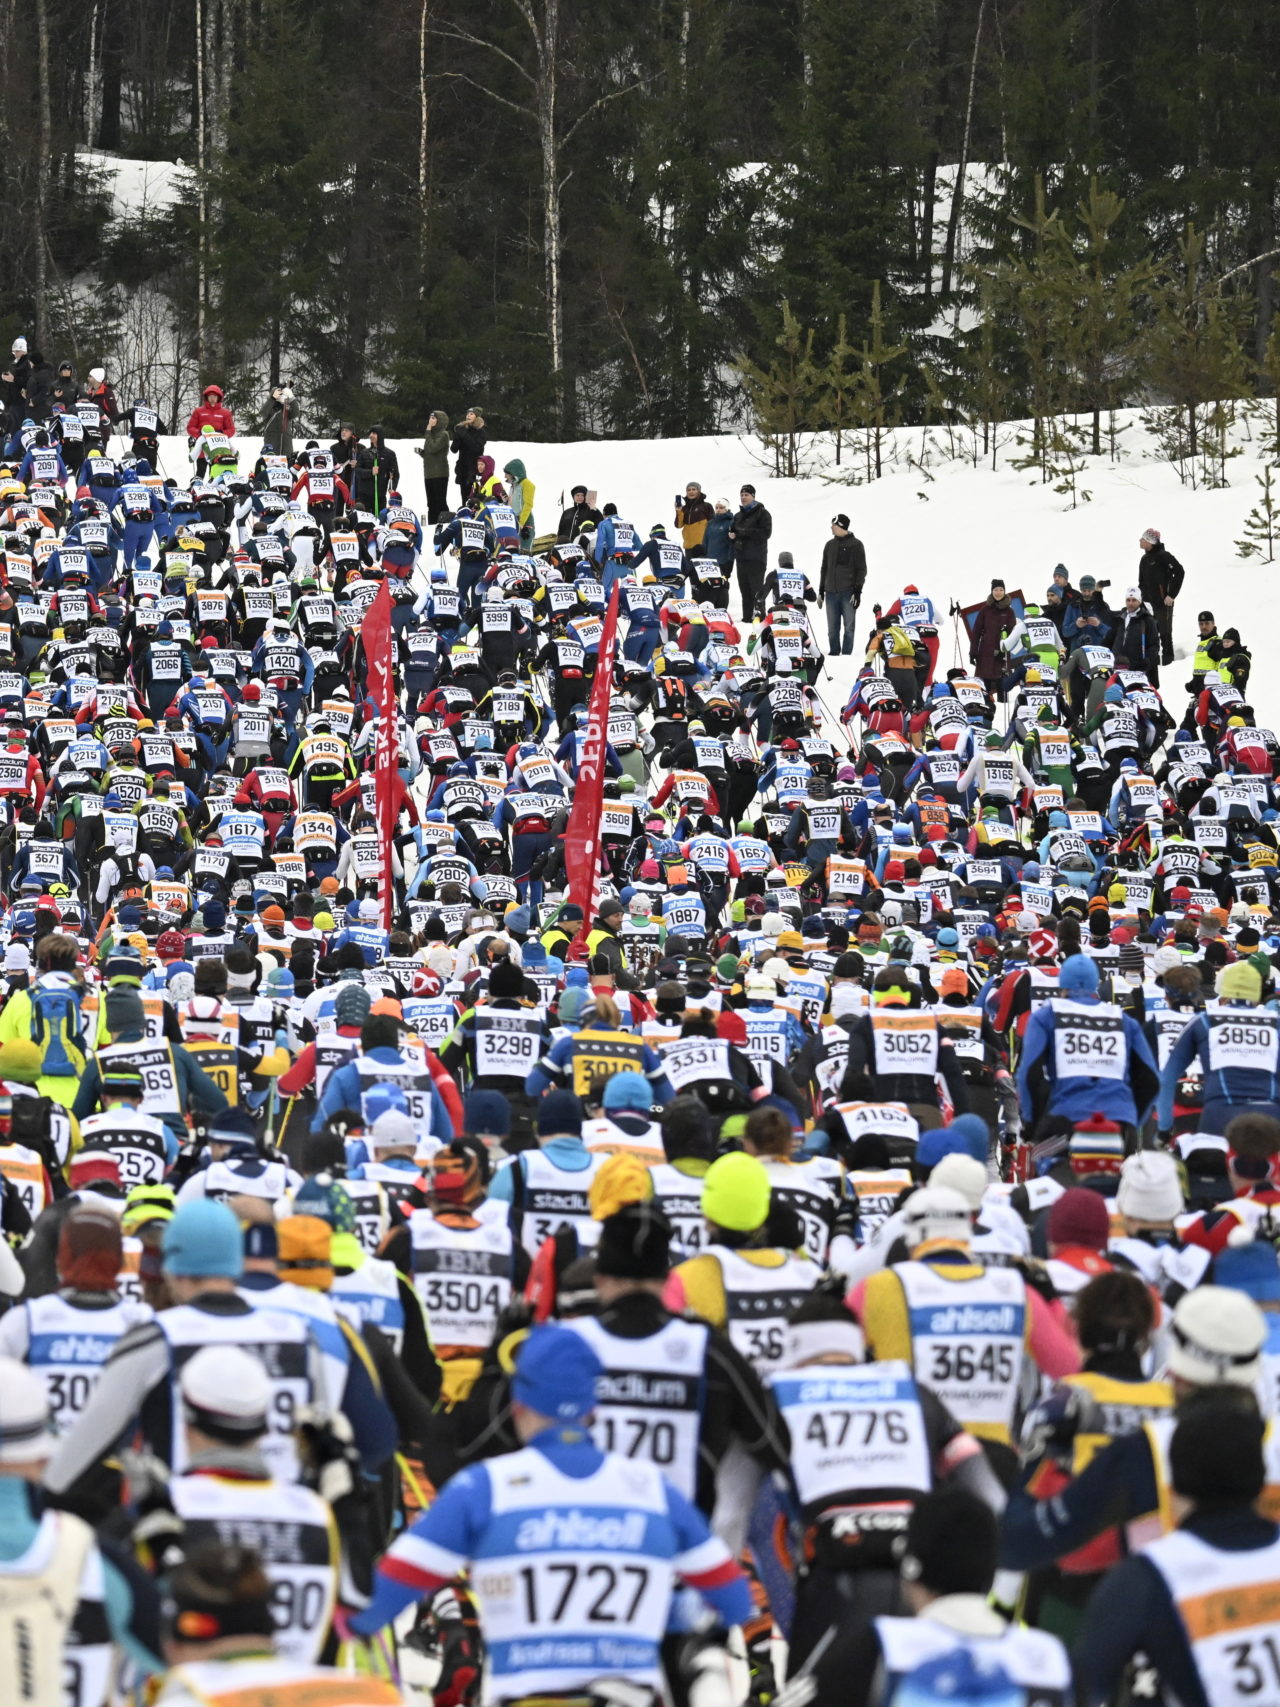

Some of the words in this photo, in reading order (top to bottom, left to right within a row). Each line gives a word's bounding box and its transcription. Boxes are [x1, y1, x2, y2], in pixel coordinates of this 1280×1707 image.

[37, 462, 56, 471] 2091
[494, 513, 514, 521] 1063
[336, 542, 357, 552] 1071
[64, 556, 84, 565] 2107
[137, 579, 159, 587] 5216
[782, 580, 803, 590] 3375
[554, 593, 576, 602] 2156
[62, 602, 86, 612] 3769
[201, 600, 225, 610] 3876
[247, 600, 274, 609] 13359
[904, 604, 927, 615] 2220
[485, 613, 509, 623] 3999
[1032, 627, 1053, 637] 2381
[777, 638, 801, 647] 3866
[155, 659, 180, 669] 2066
[269, 655, 296, 669] 1420
[497, 701, 520, 711] 2189
[325, 712, 350, 724] 3398
[244, 721, 266, 732] 2011
[610, 722, 633, 733] 4192
[147, 745, 172, 756] 3245
[310, 743, 339, 753] 1495
[1045, 744, 1068, 754] 4764
[74, 751, 98, 762] 2215
[934, 763, 958, 773] 3624
[986, 768, 1013, 780] 13165
[453, 786, 482, 798] 1042
[679, 781, 707, 792] 13216
[115, 786, 142, 799] 1520
[146, 814, 174, 826] 1569
[605, 814, 630, 825] 3608
[813, 816, 838, 828] 5217
[228, 823, 259, 836] 1617
[302, 822, 333, 836] 1344
[1199, 828, 1225, 838] 2328
[696, 846, 725, 858] 2416
[739, 848, 766, 859] 1667
[35, 853, 60, 864] 3671
[200, 856, 226, 866] 4170
[435, 870, 467, 883] 2802
[833, 874, 860, 884] 2148
[1026, 895, 1050, 906] 3510
[670, 909, 700, 923] 1887
[389, 961, 423, 969] stadium
[411, 1005, 448, 1016] ahlsell
[411, 1018, 449, 1033] 3264
[491, 1017, 527, 1030] IBM
[1060, 1017, 1118, 1028] VOLVO
[1213, 1017, 1272, 1025] VOLVO
[1217, 1029, 1271, 1046] 3850
[485, 1034, 532, 1056] 3298
[579, 1044, 639, 1053] VOLVO
[884, 1035, 931, 1053] 3052
[1064, 1033, 1117, 1055] 3642
[670, 1051, 718, 1073] 3331
[437, 1250, 491, 1273] IBM
[426, 1281, 502, 1312] 3504
[931, 1306, 1014, 1330] ahlsell
[932, 1345, 1014, 1382] 3645
[800, 1380, 896, 1399] ahlsell
[806, 1411, 909, 1447] 4776
[516, 1515, 648, 1549] ahlsell
[520, 1565, 649, 1624] 1727
